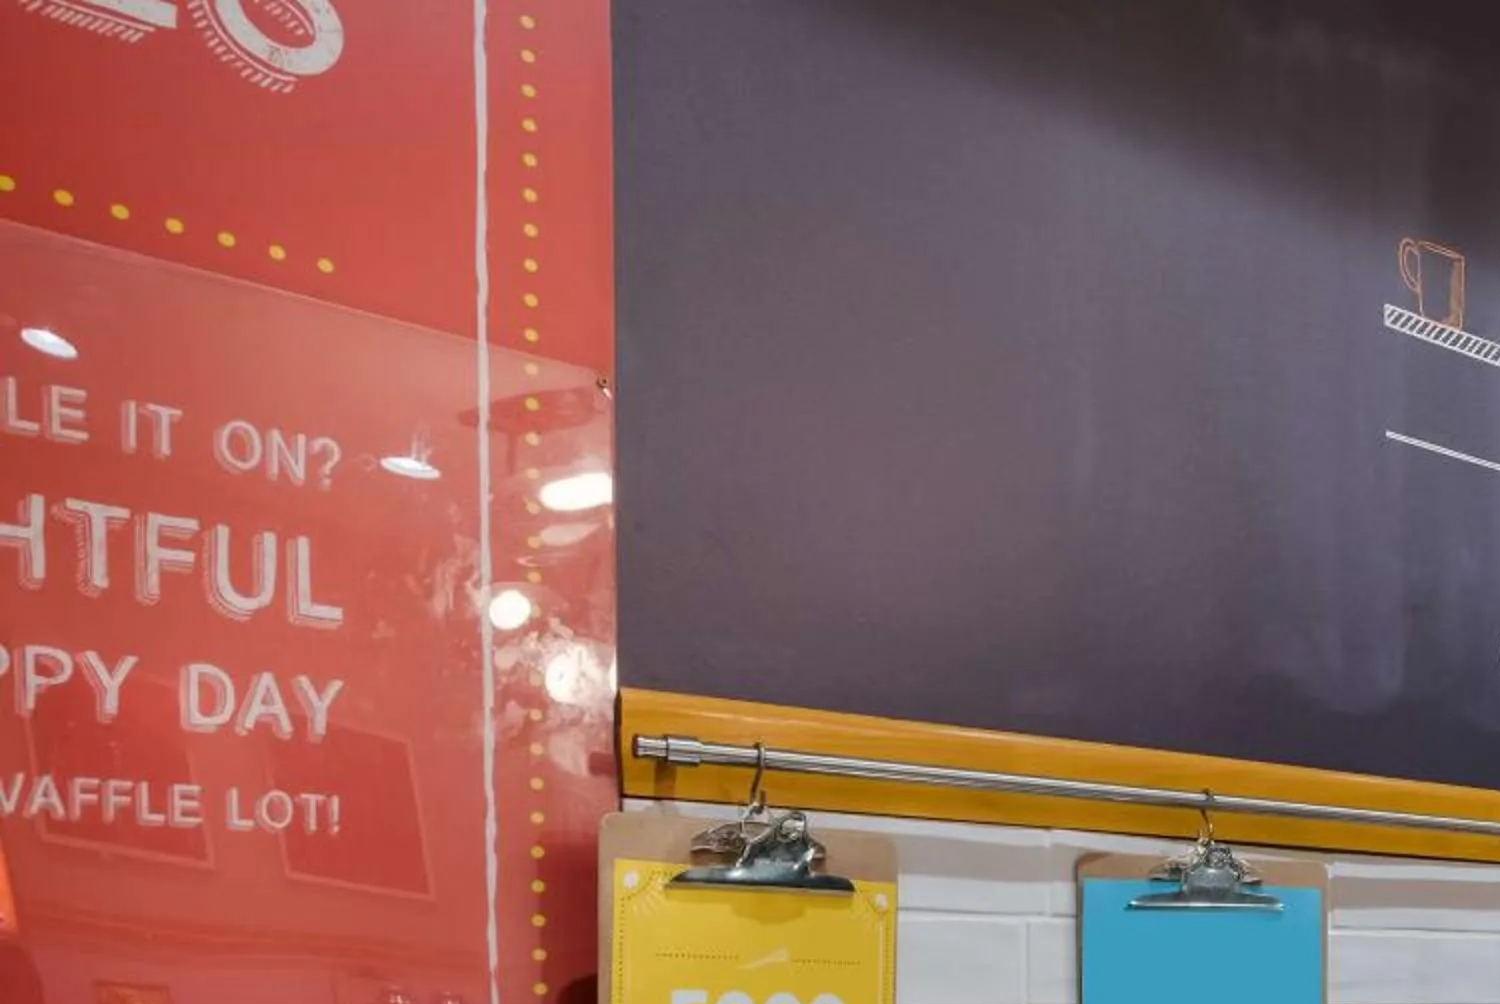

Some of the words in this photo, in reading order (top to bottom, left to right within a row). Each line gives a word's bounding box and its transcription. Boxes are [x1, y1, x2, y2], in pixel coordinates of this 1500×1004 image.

[117, 400, 183, 459] IT
[213, 419, 342, 491] ON?
[0, 643, 139, 724] PY
[179, 663, 344, 743] DAY
[226, 786, 341, 836] LOT!
